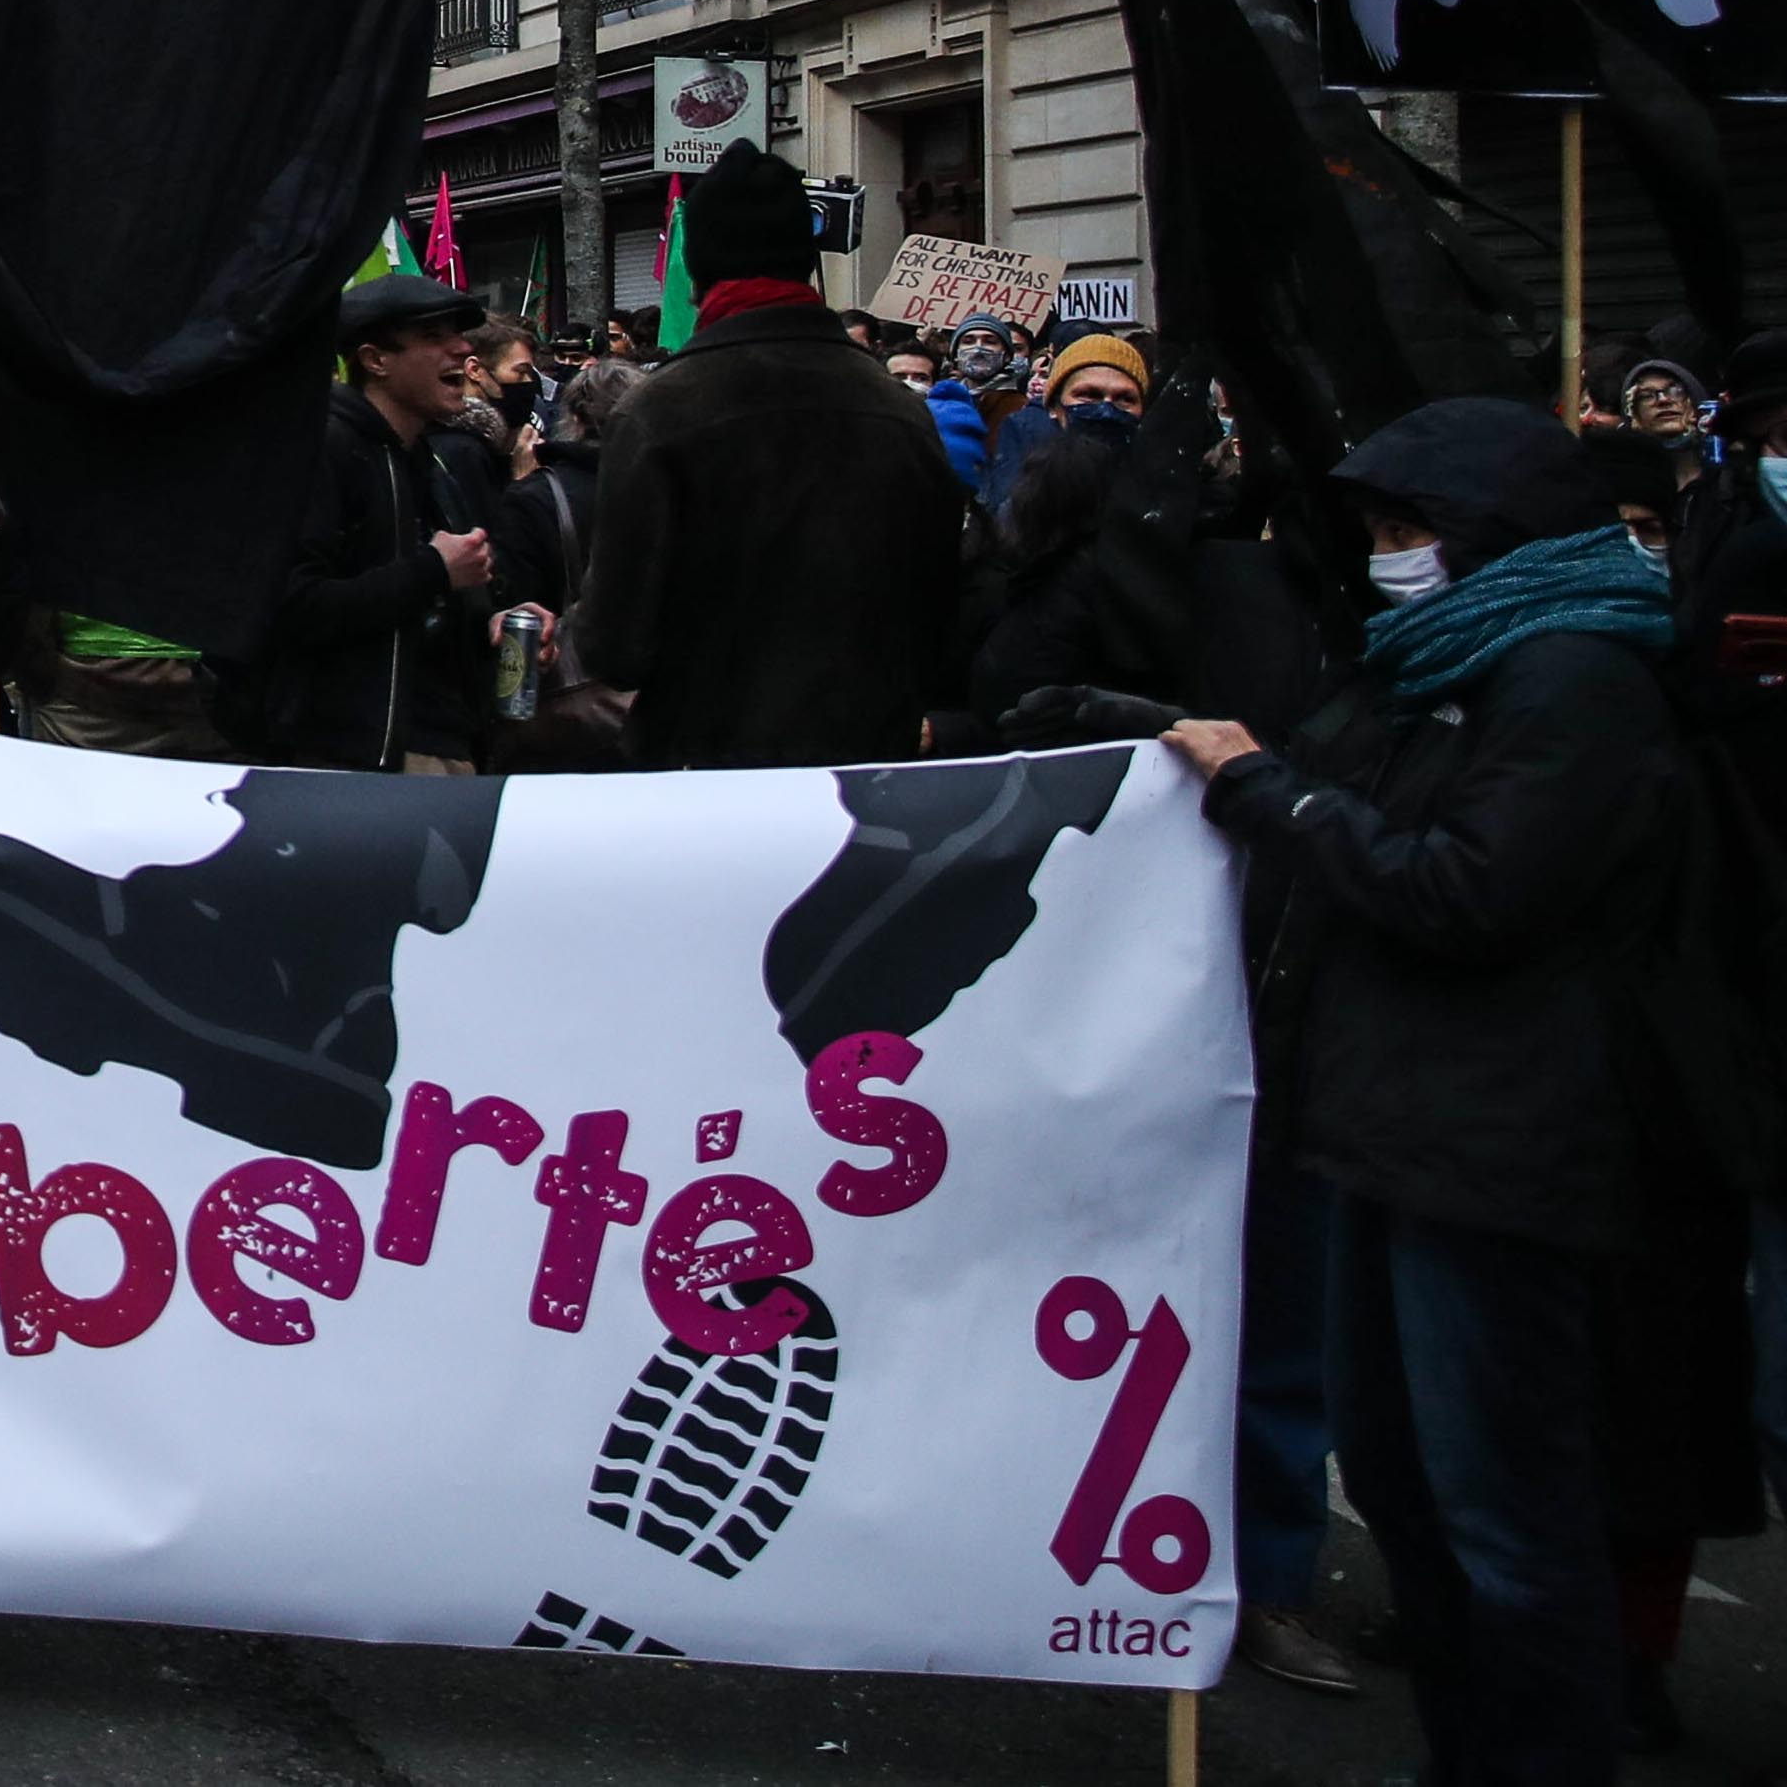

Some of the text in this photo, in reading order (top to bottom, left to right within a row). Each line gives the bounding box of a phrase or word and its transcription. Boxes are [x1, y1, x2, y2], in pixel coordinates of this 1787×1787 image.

[663, 146, 721, 165] boula
[672, 137, 723, 153] artisan
[909, 235, 1032, 268] ALL I WANT
[895, 249, 1050, 291] FOR CHRISTMAS
[891, 268, 1053, 315] IS RETRAIT
[901, 294, 946, 325] DE
[1048, 1607, 1193, 1660] attac
